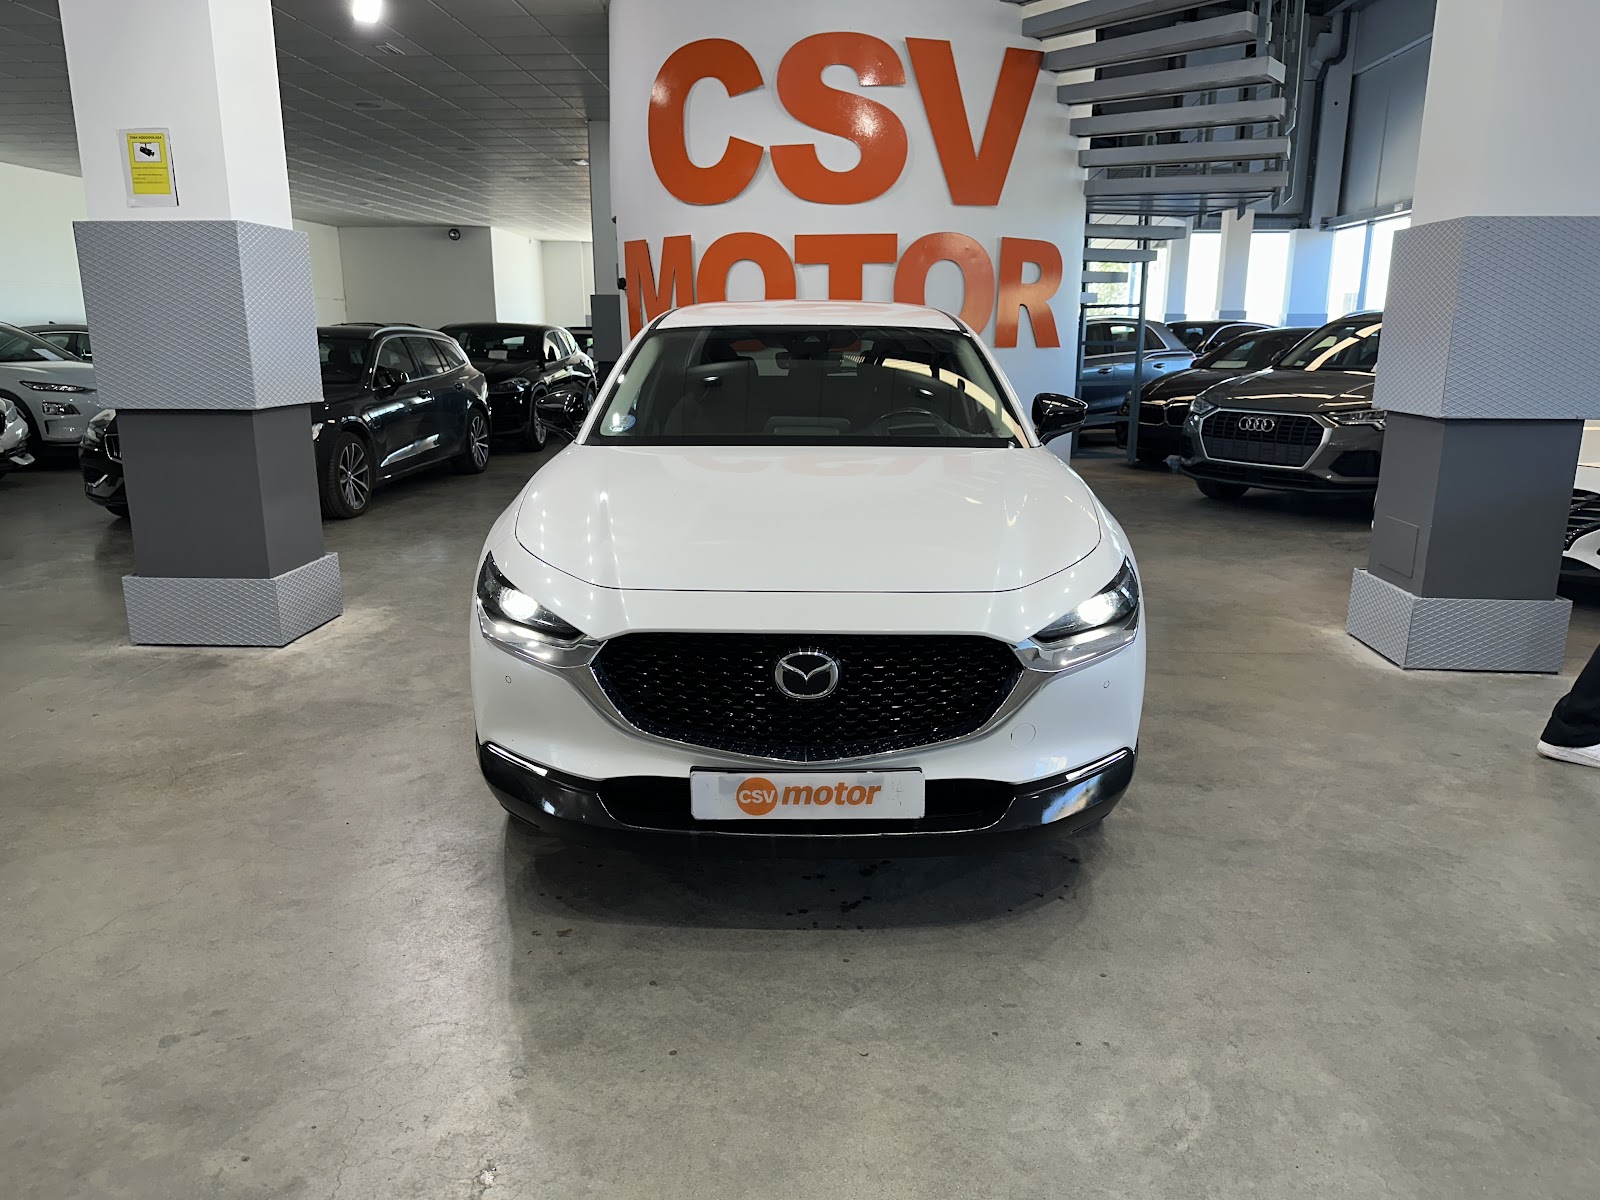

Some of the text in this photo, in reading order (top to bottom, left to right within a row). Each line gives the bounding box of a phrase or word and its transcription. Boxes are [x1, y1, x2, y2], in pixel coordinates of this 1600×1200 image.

[648, 31, 1044, 206] CSV
[624, 231, 1063, 348] MOTOR
[782, 782, 882, 805] motor
